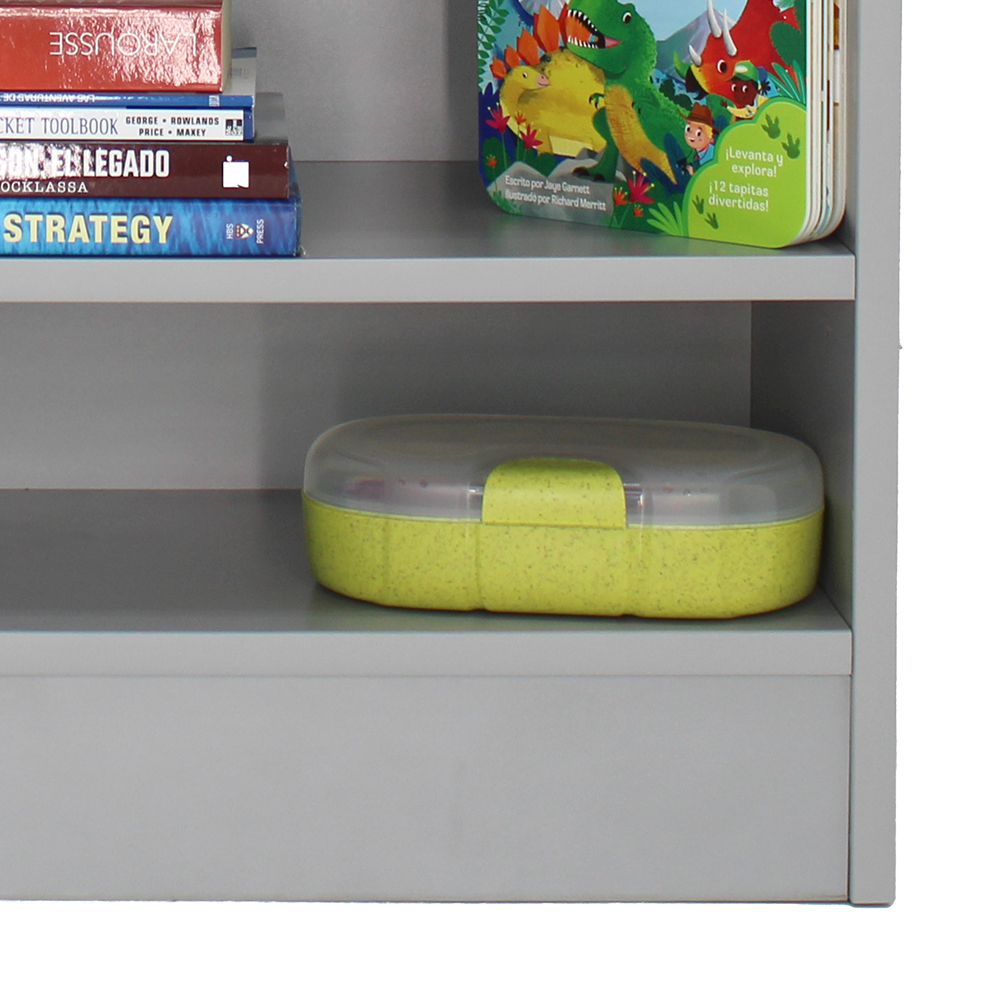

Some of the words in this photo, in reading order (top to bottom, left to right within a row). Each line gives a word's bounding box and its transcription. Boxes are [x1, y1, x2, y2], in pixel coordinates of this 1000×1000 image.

[49, 31, 197, 56] LAROUSSE
[3, 93, 16, 101] DE
[41, 117, 118, 135] TOOLBOOK
[125, 116, 159, 125] GEORGE
[170, 116, 220, 126] ROWLANDS
[138, 128, 164, 137] PRICE
[176, 128, 207, 137] MAXEY
[83, 149, 170, 178] LEGADO
[725, 146, 774, 162] ¡Levanta
[776, 154, 783, 167] y
[731, 163, 777, 178] explora!
[505, 174, 531, 188] Escrito
[531, 181, 544, 191] por
[728, 182, 769, 197] tapitas
[537, 195, 551, 205] por
[551, 194, 579, 207] Richard
[708, 193, 769, 212] divertidas!
[3, 212, 173, 244] STRATEGY
[225, 223, 234, 240] HBS
[255, 218, 265, 245] PRESS
